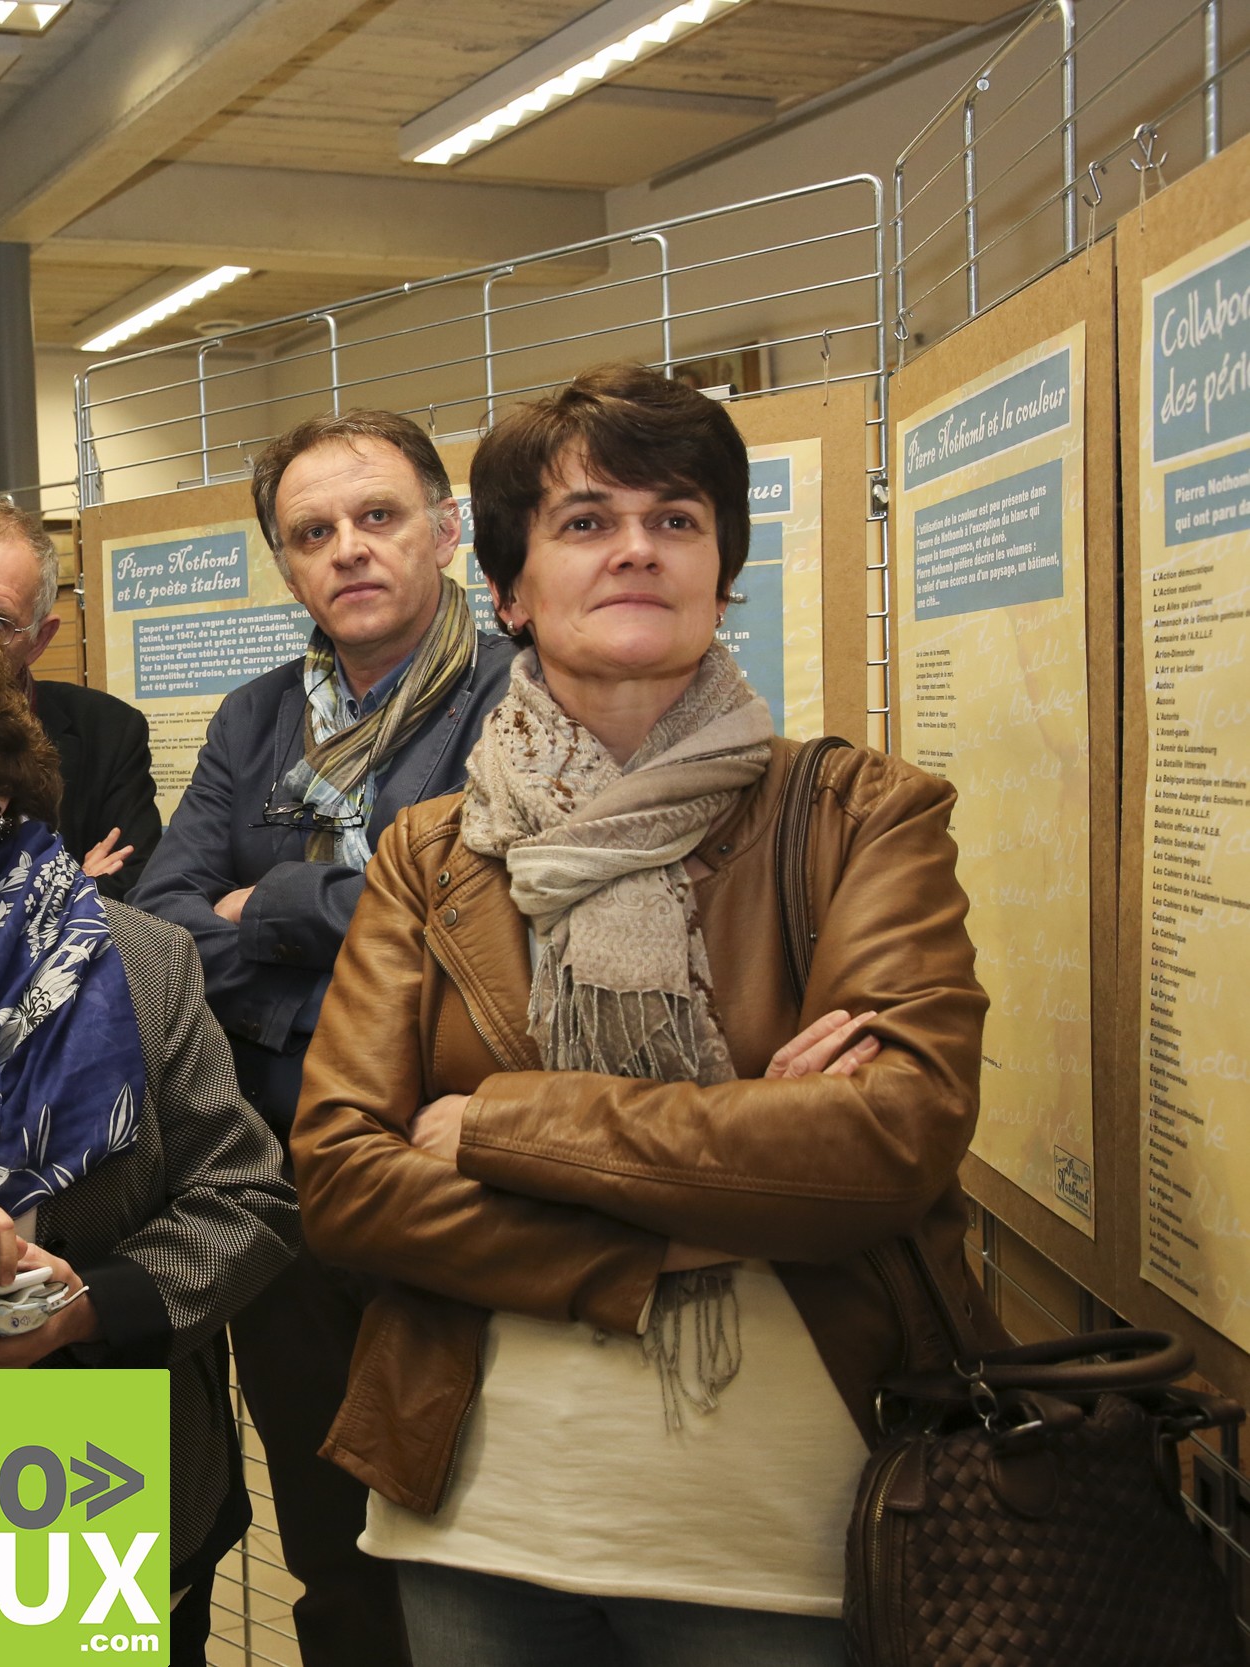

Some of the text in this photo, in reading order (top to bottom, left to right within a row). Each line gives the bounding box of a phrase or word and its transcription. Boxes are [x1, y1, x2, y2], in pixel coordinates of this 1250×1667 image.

[1161, 352, 1250, 434] des péri
[907, 379, 1066, 474] Pierre Nothomb et la couleur
[749, 482, 783, 500] ue
[1175, 485, 1205, 504] Pierre
[916, 485, 1047, 536] L'utilisation de la couleur est peu présente dans
[1175, 512, 1191, 534] qui
[1193, 508, 1210, 527] ont
[1212, 505, 1237, 526] paru
[934, 534, 940, 545] de
[940, 526, 964, 544] Nothomb
[969, 515, 1001, 536] l'exception
[1001, 513, 1010, 525] du
[1010, 509, 1028, 523] blanc
[1030, 502, 1040, 519] qui
[934, 549, 939, 560] la
[939, 541, 975, 559] transparence,
[976, 537, 982, 549] et
[983, 535, 991, 547] du
[992, 530, 1007, 543] doré.
[117, 544, 240, 580] Pierre Nothomb
[916, 568, 931, 580] Pierre
[932, 560, 954, 576] Nothomb
[974, 550, 995, 566] décrire
[996, 548, 1005, 561] les
[1006, 542, 1032, 558] volumes
[916, 551, 1060, 594] le relief d'une écorce ou d'un paysage, un bâtiment,
[117, 570, 241, 606] et le poète italien
[917, 598, 925, 609] une
[139, 623, 169, 634] Emporté
[171, 623, 184, 632] par
[201, 619, 225, 629] vague
[226, 617, 237, 625] de
[238, 613, 289, 624] romantisme,
[475, 610, 489, 619] Né
[176, 631, 197, 640] 1947,
[198, 630, 208, 638] de
[210, 629, 218, 637] la
[220, 628, 236, 638] part
[238, 626, 248, 634] de
[250, 622, 295, 633] l'Académie
[734, 631, 750, 639] un
[140, 640, 202, 653] luxembourgeoise
[140, 653, 175, 662] l'érection
[236, 645, 271, 655] mémoire
[140, 664, 153, 672] Sur
[163, 662, 188, 672] plaque
[201, 659, 229, 668] marbre
[243, 656, 274, 664] Carrare
[141, 674, 147, 682] le
[149, 672, 186, 681] monolithe
[188, 670, 225, 678] d'ardoise,
[169, 681, 193, 691] gravés
